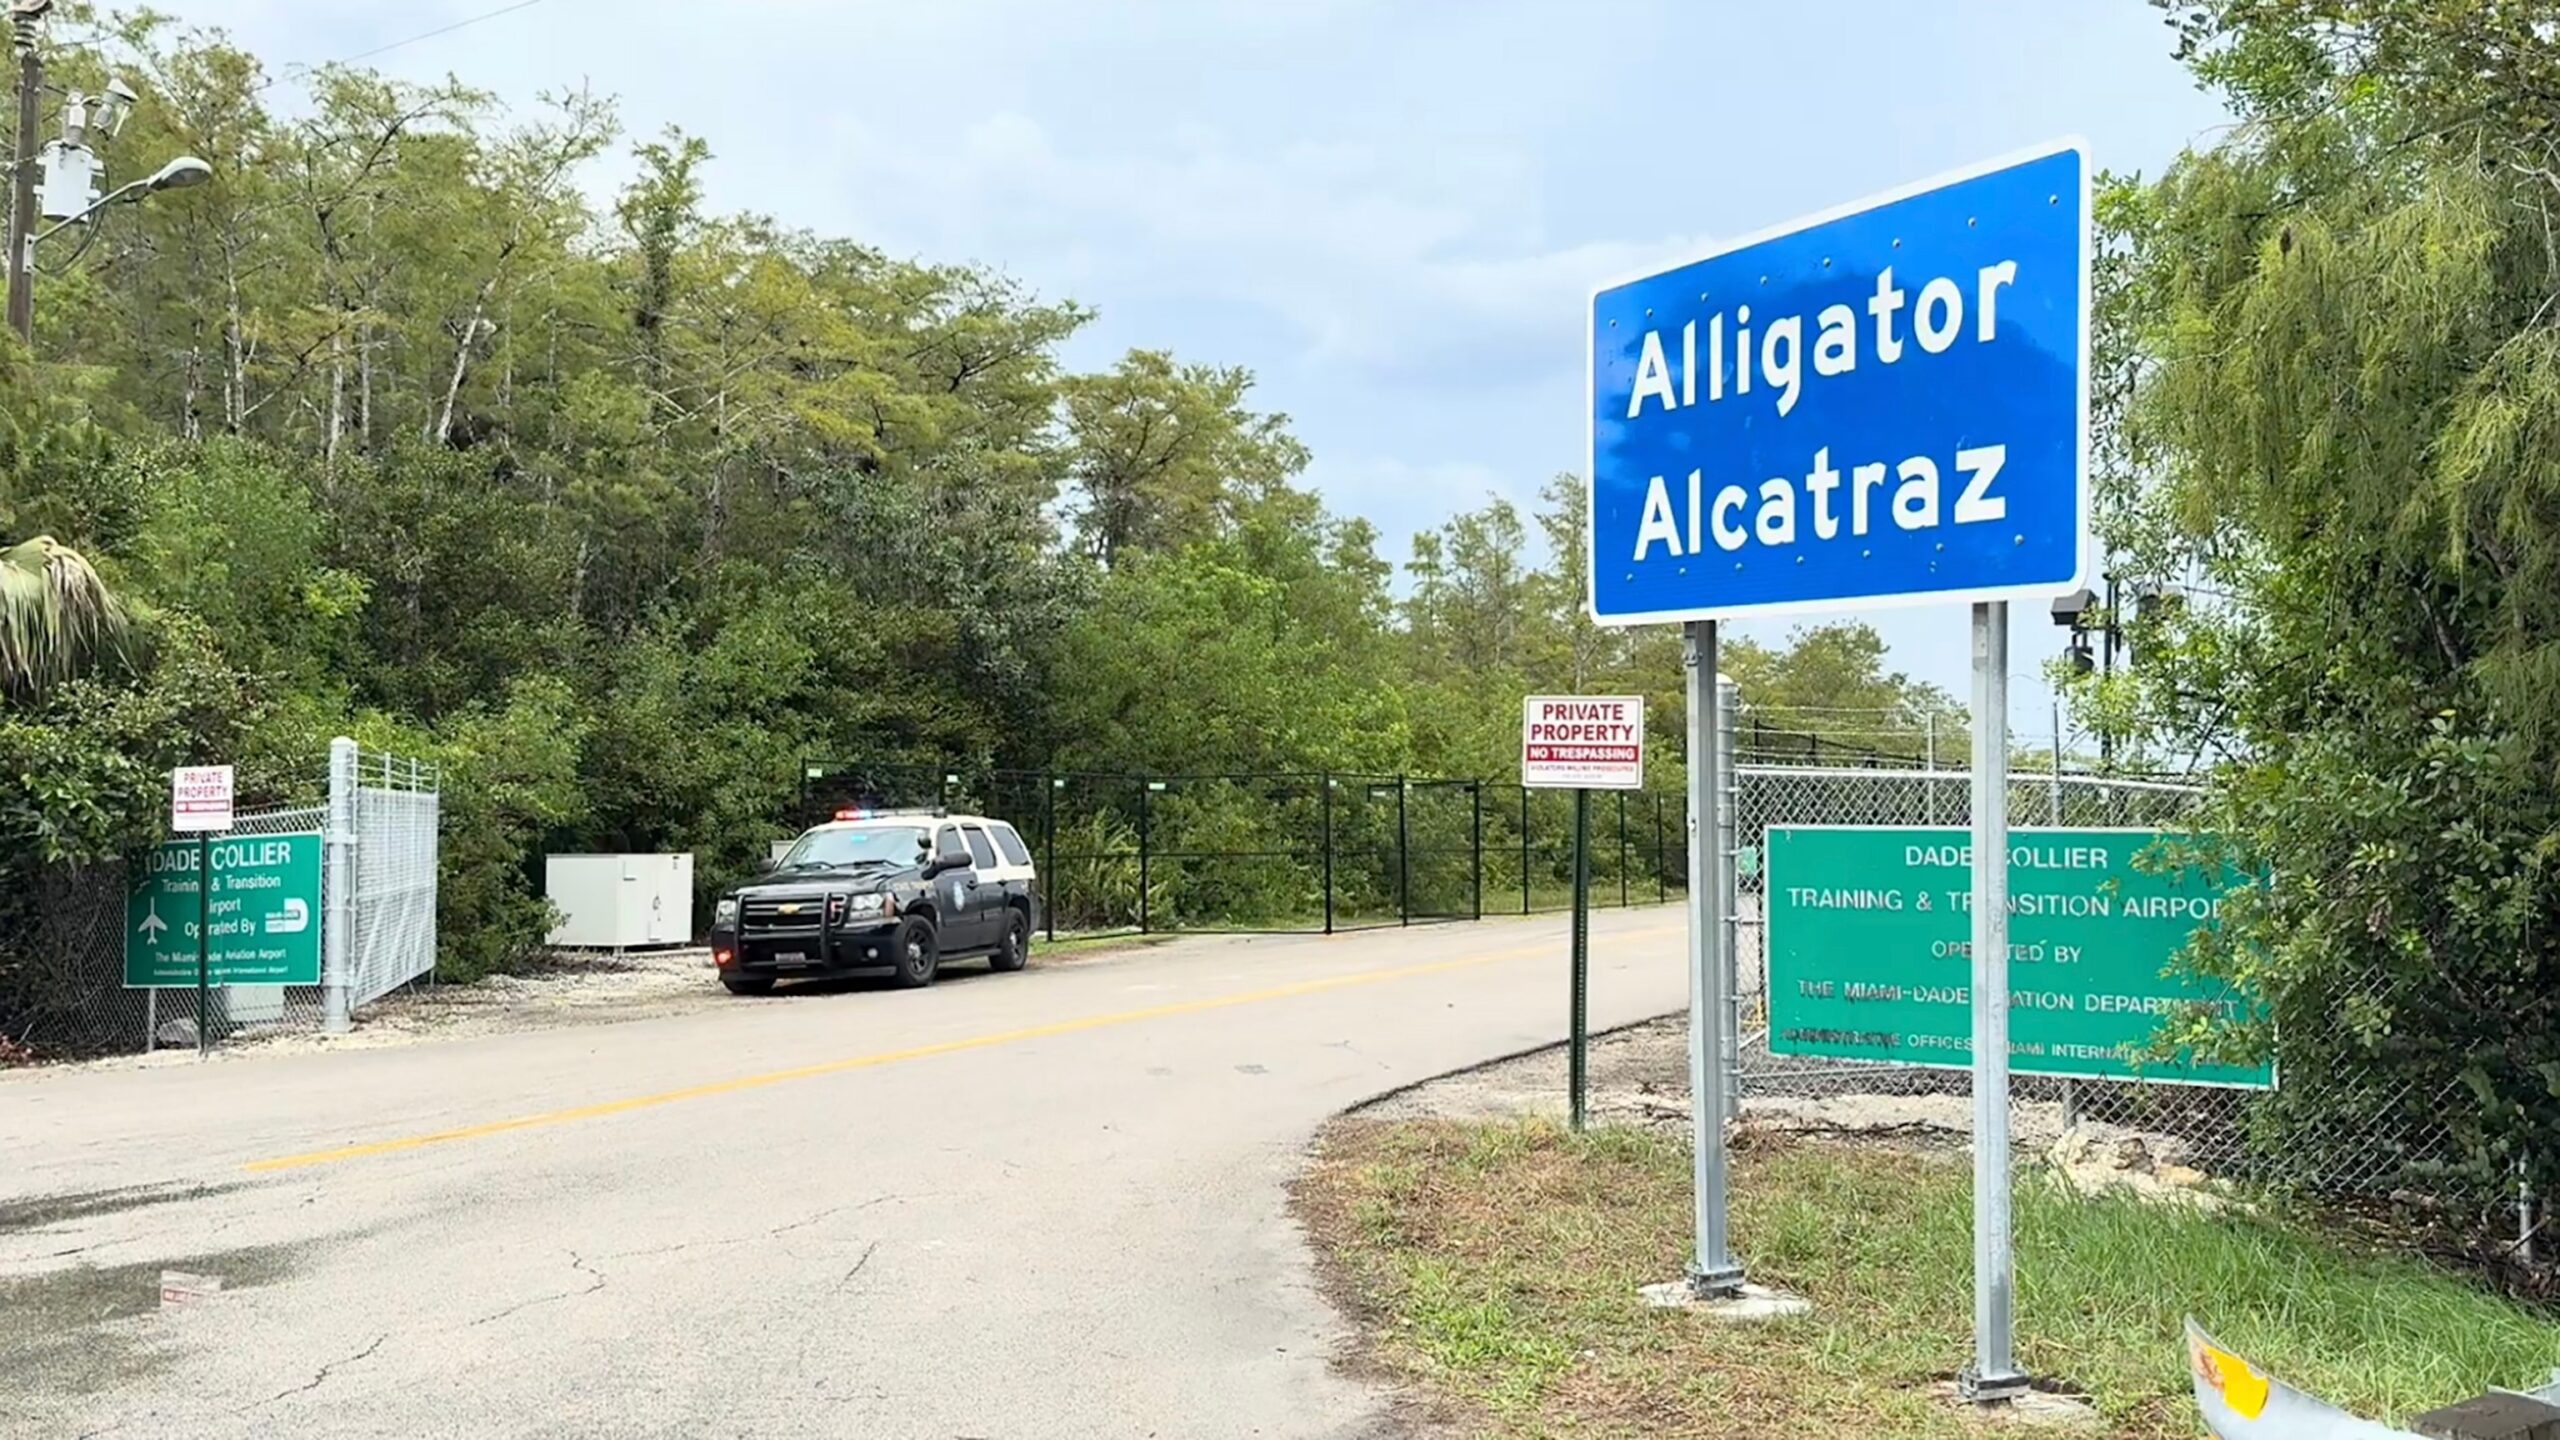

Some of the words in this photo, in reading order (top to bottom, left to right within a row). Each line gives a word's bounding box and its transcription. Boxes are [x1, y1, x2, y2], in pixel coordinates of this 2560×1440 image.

[1627, 259, 2018, 418] Alligator
[1632, 444, 2007, 562] Alcatraz
[1543, 703, 1624, 721] PRIVATE
[1531, 723, 1635, 741] PROPERTY
[1530, 747, 1548, 759] NO
[1551, 747, 1636, 760] TRESPASSING
[178, 785, 228, 798] PROPERTY
[152, 848, 200, 873] DADE
[210, 841, 291, 871] COLLIER
[1905, 845, 1972, 867] DADE
[2007, 846, 2109, 869] OLLIER
[161, 876, 199, 893] Trainin
[211, 876, 221, 892] &
[225, 872, 281, 890] Transition
[208, 897, 242, 917] irport
[1786, 887, 1903, 911] TRAINING
[1915, 890, 1932, 912] &
[1946, 891, 2110, 917] TRNSITION
[2122, 896, 2221, 919] AIRPO
[184, 919, 238, 939] Oprated
[240, 917, 257, 936] By
[1931, 940, 2044, 962] OPETED
[2055, 945, 2082, 963] BY
[1798, 979, 1835, 998] THE
[1844, 981, 1969, 1005] MIAMI-DADE
[2009, 989, 2074, 1011] ATION
